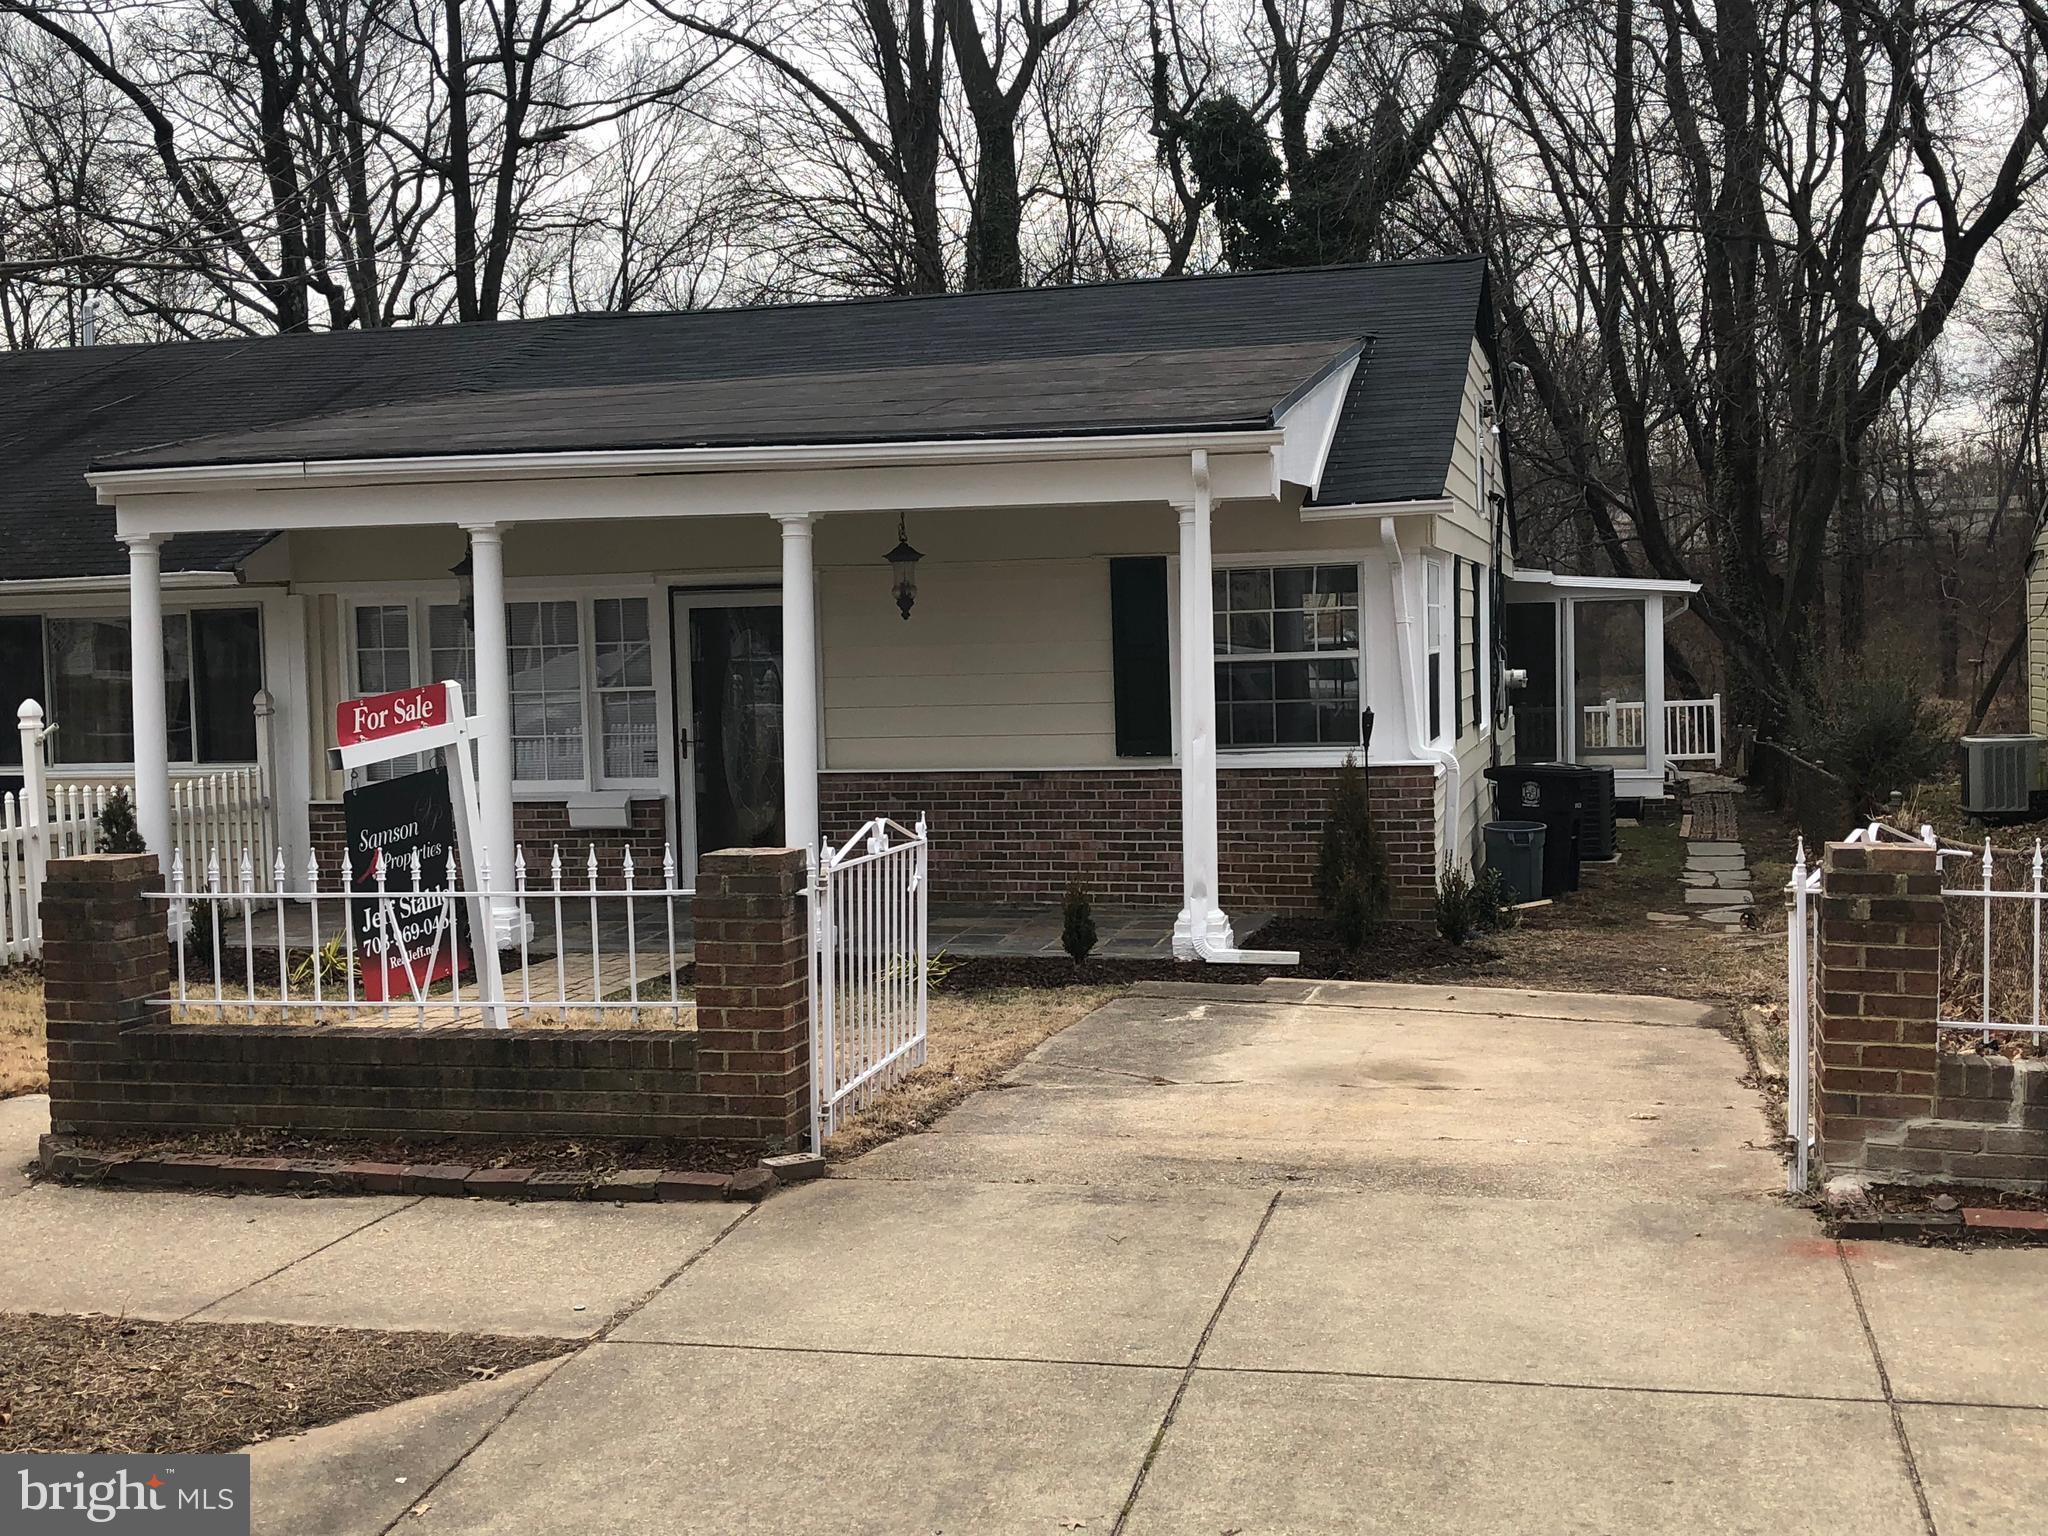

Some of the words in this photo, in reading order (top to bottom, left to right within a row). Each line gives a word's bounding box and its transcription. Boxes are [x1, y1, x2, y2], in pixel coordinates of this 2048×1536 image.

[352, 705, 389, 733] For
[394, 694, 434, 725] Sale
[358, 821, 419, 853] Samson
[384, 841, 442, 871] Proprties
[362, 899, 396, 932] Jef
[363, 915, 458, 957] 70-69-04
[389, 945, 439, 969] ReJeff.n
